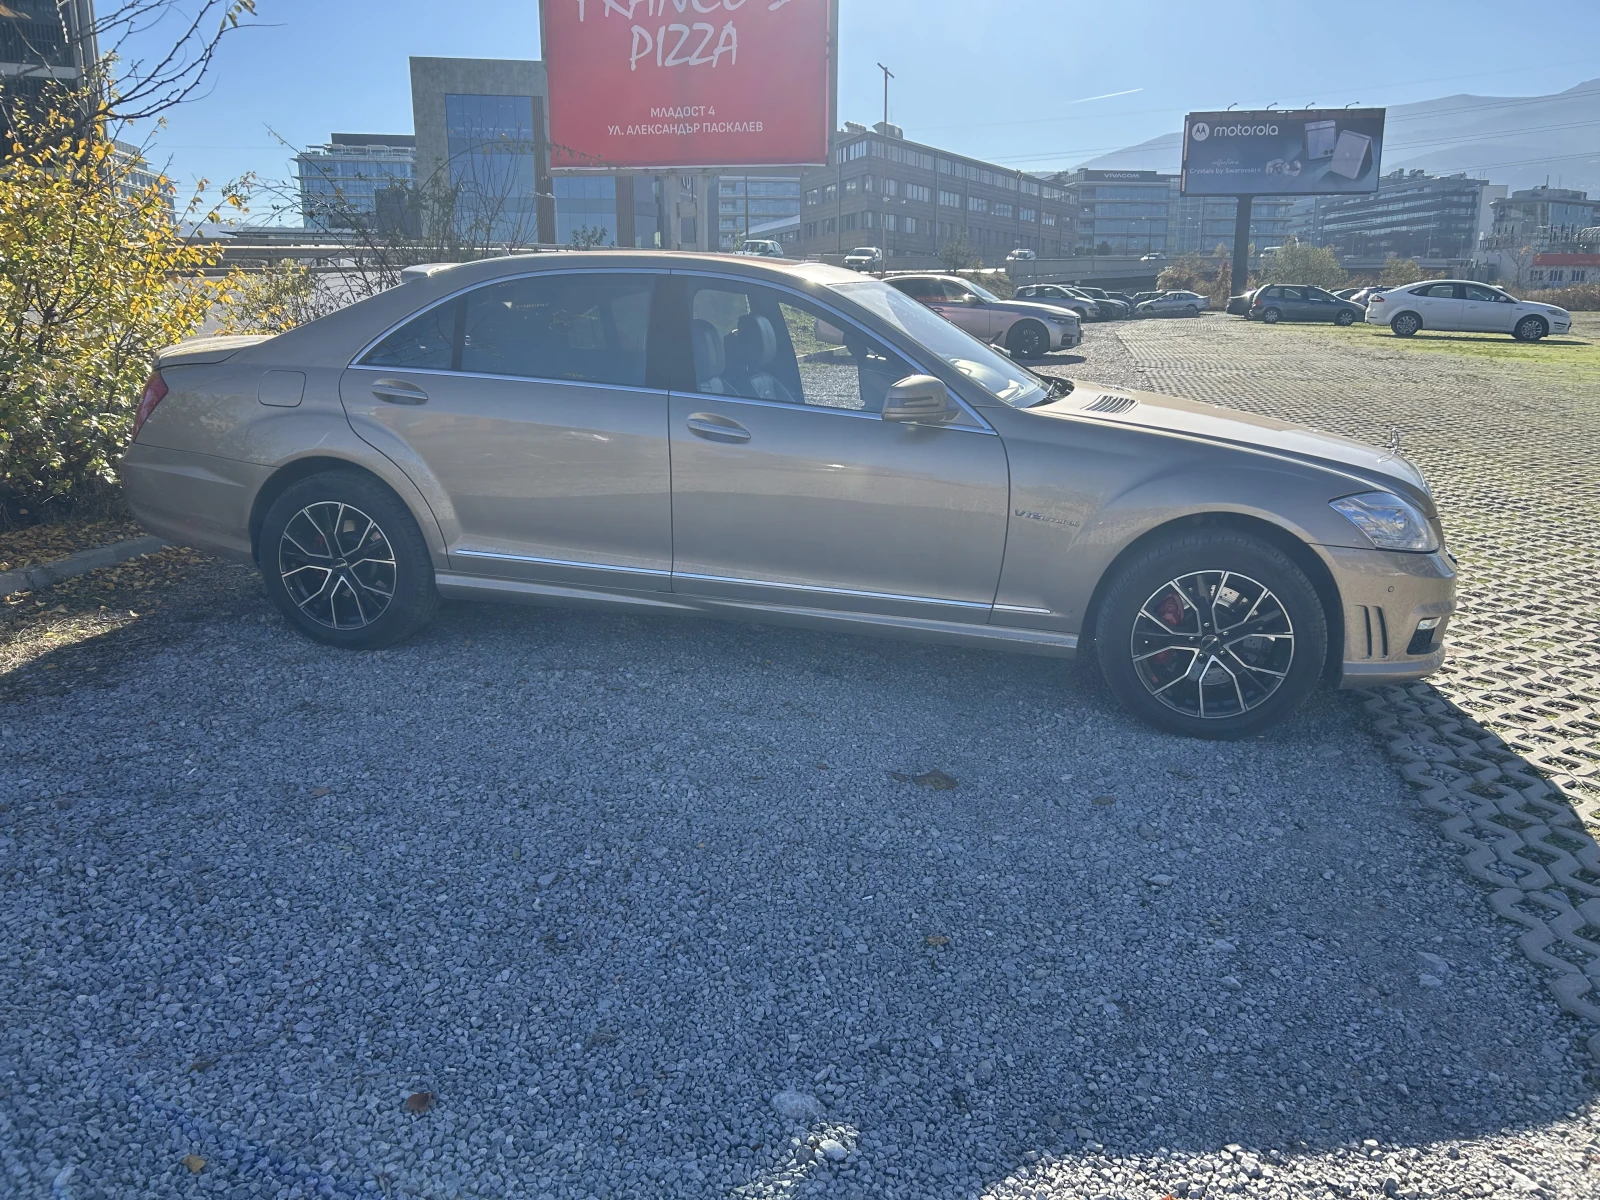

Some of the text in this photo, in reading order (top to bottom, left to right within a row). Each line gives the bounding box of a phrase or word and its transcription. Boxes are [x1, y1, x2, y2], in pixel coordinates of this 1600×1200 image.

[629, 20, 738, 71] PIZZA
[650, 105, 716, 119] МЛАДОСТ 4
[607, 121, 764, 136] УЛ. АЛЕКСАНДЪР ПАСКАЛЕВ
[1213, 123, 1279, 137] motorola
[1189, 167, 1214, 175] Crystals
[1215, 167, 1224, 175] by
